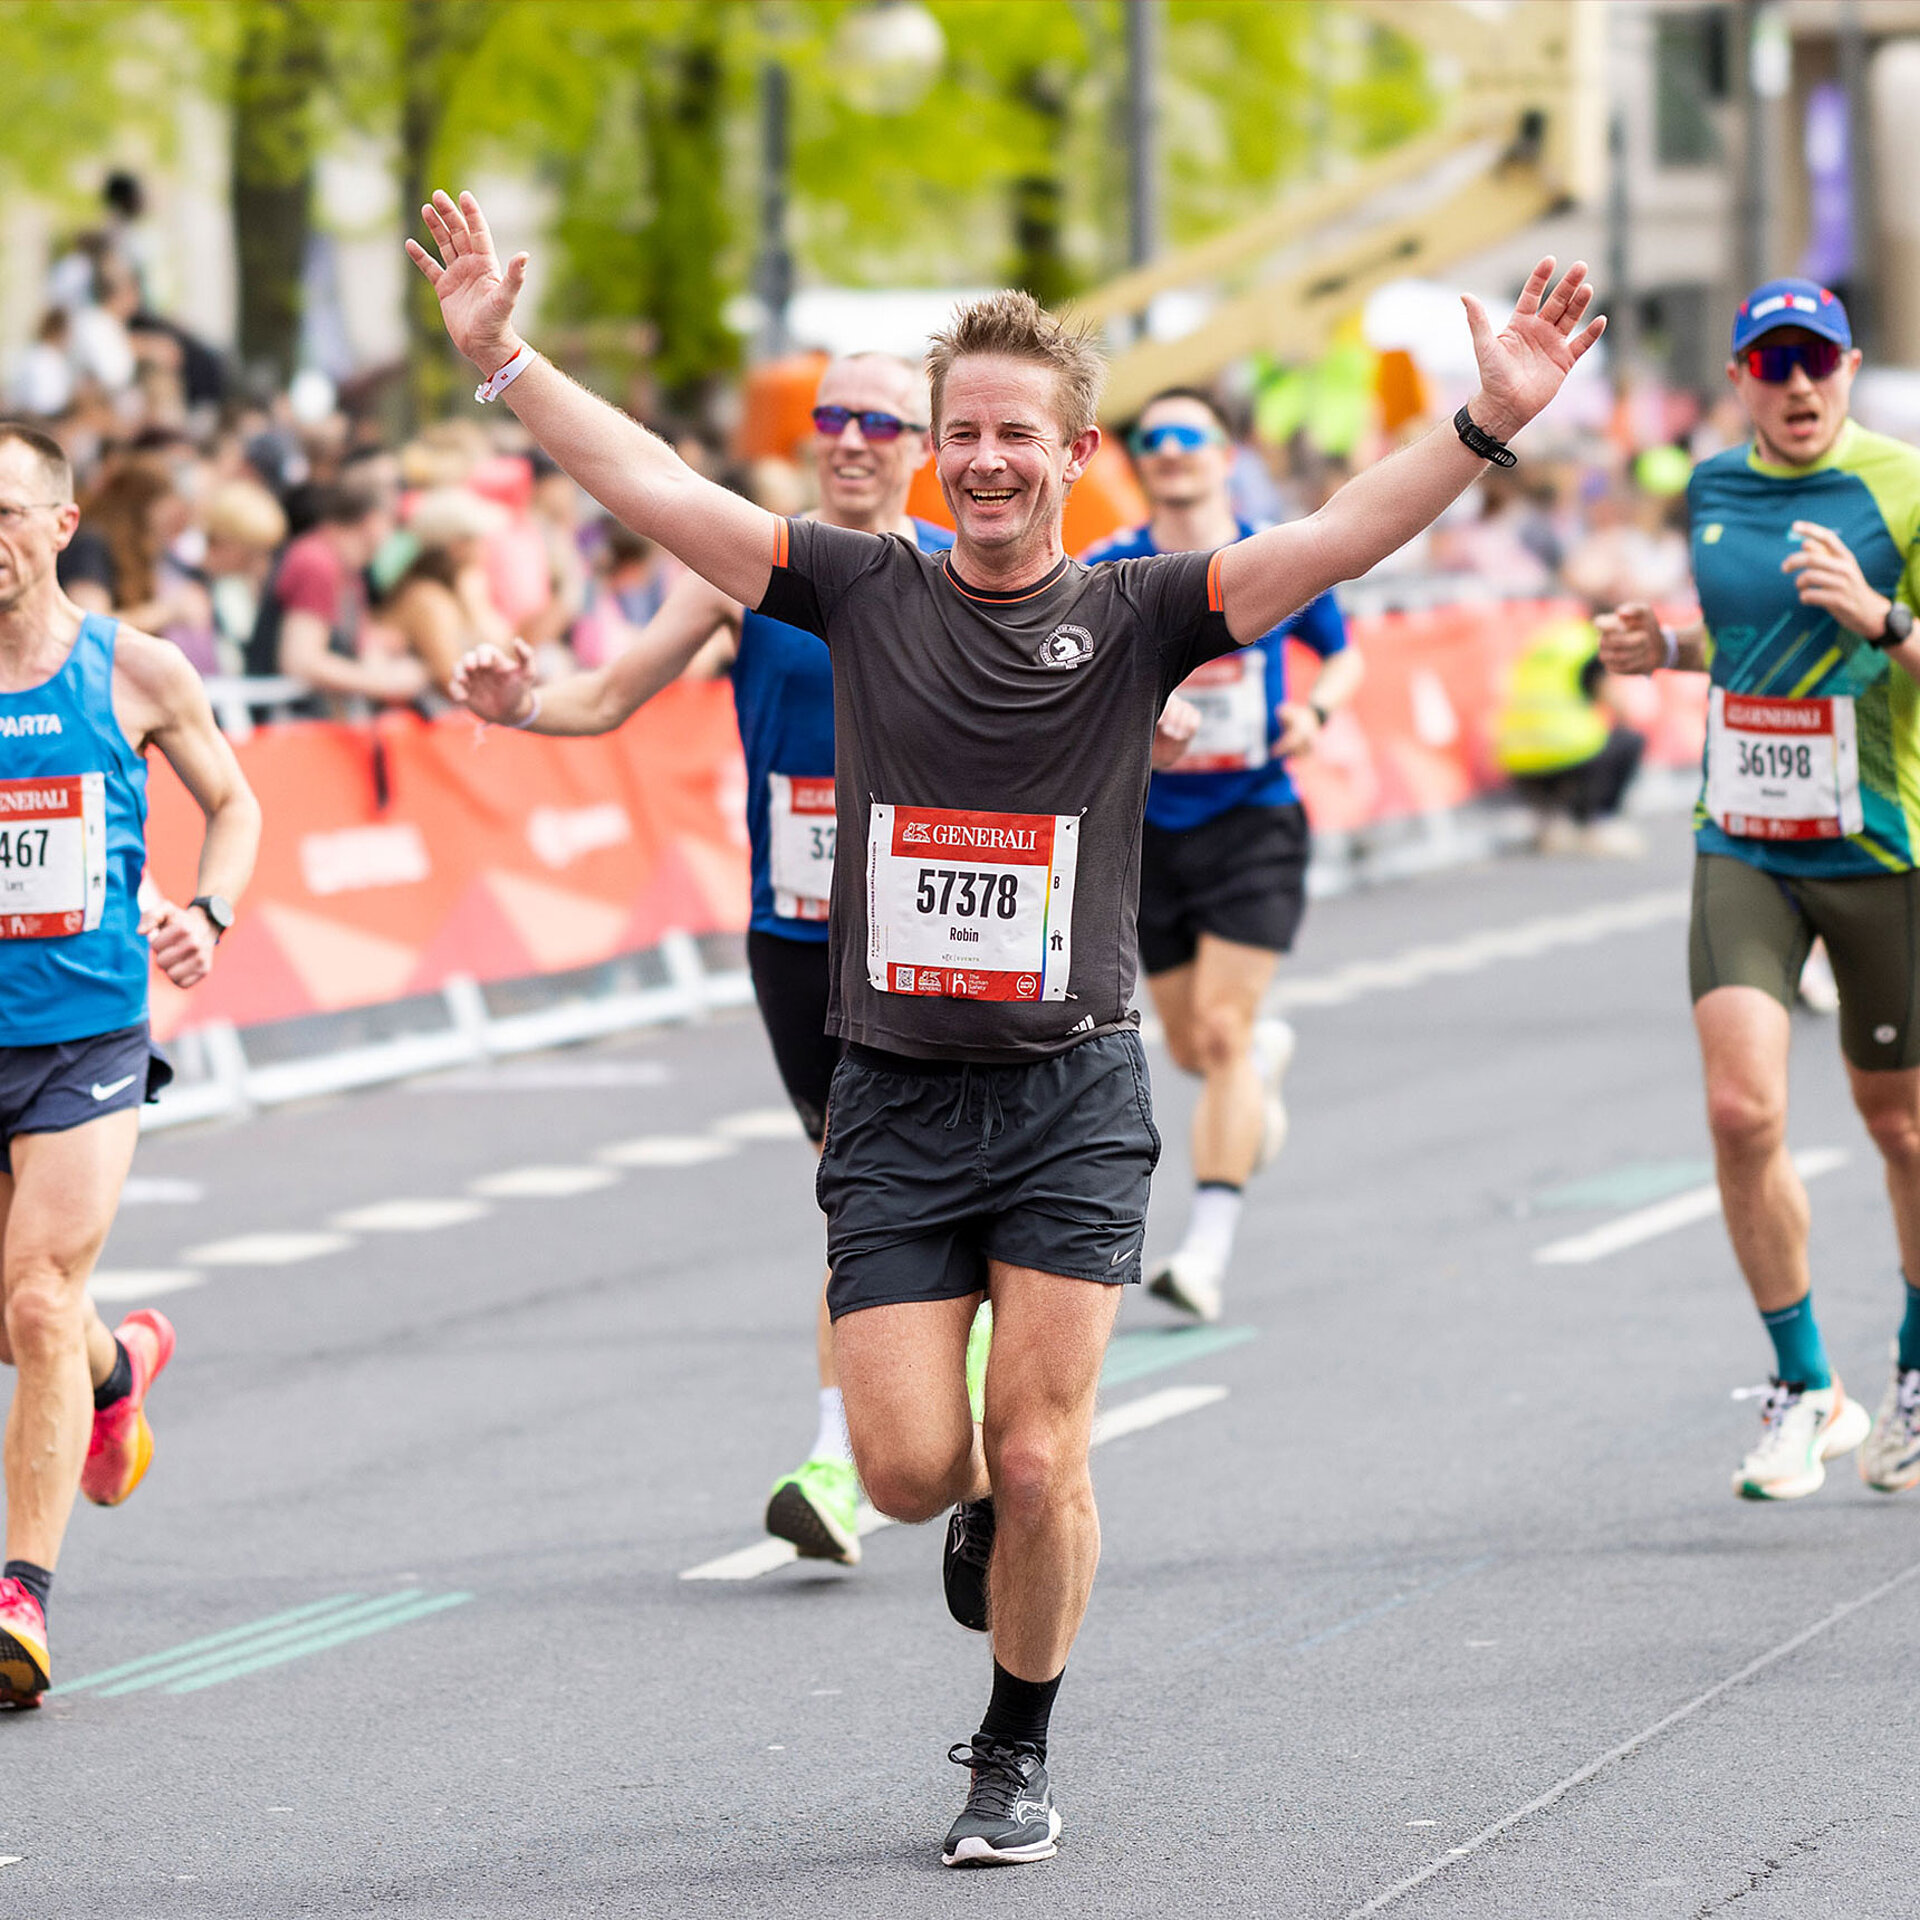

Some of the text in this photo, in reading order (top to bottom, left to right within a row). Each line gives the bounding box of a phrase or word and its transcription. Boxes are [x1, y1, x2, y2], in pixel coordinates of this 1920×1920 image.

[1739, 741, 1811, 779] 36198
[0, 829, 49, 868] 467
[932, 824, 1037, 850] GENERALI
[916, 868, 1018, 919] 57378
[1054, 876, 1060, 889] B
[950, 927, 979, 942] Robin
